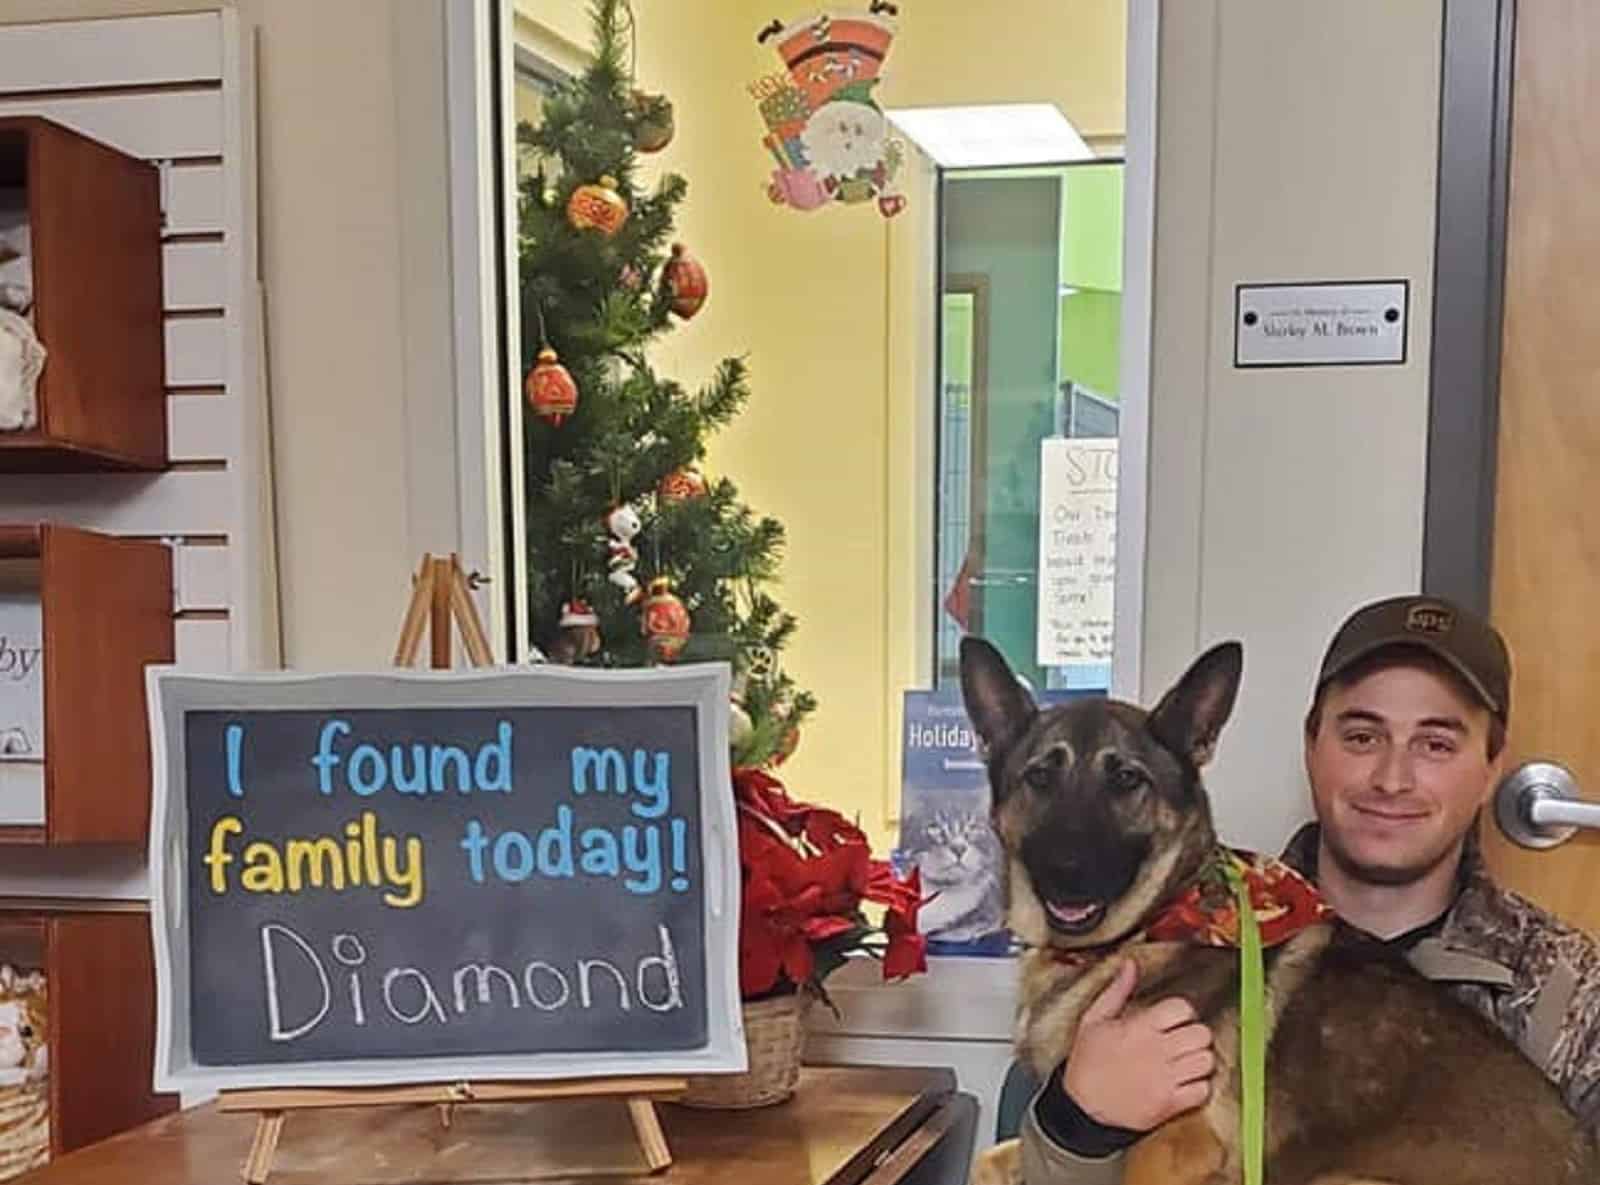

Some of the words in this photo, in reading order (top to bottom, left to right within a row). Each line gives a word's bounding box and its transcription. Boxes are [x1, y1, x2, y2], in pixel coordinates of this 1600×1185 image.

[225, 724, 245, 796] I
[311, 719, 514, 796] found
[571, 744, 671, 818] my
[203, 811, 424, 908] family
[460, 803, 690, 894] today!
[262, 923, 685, 1041] Diamond
